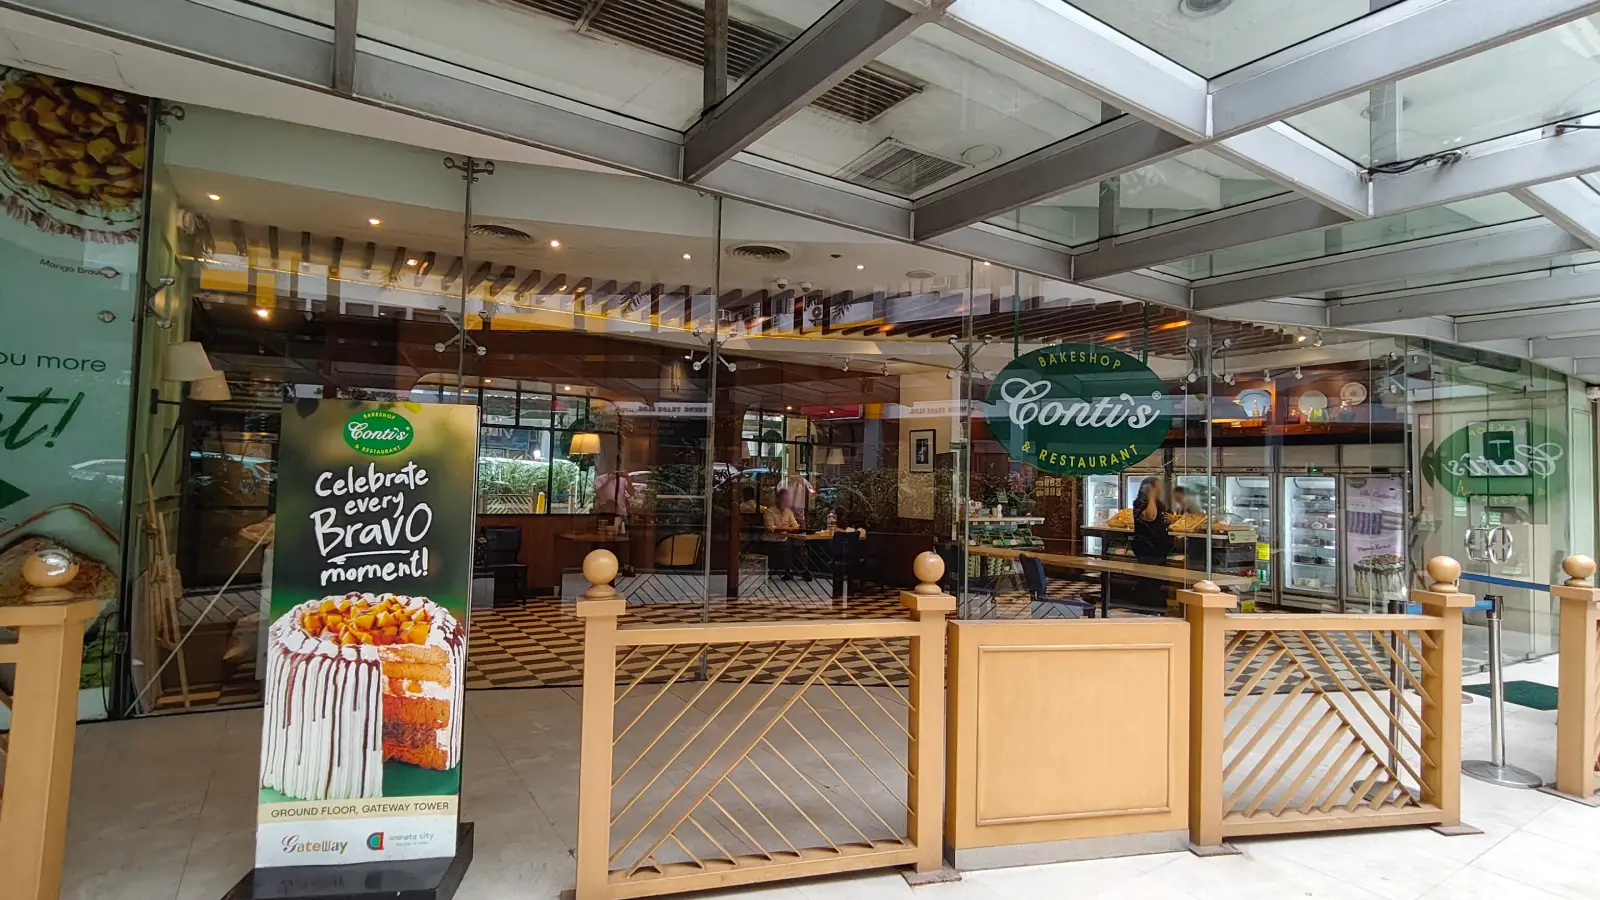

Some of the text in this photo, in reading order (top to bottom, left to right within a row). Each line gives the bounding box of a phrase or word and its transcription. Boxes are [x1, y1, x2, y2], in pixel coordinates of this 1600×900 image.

[40, 259, 75, 273] Mango
[36, 355, 107, 372] more
[1038, 351, 1121, 370] BAKESHOP
[363, 412, 396, 420] BAKESHOP
[348, 421, 409, 441] Conti's
[362, 445, 401, 455] RESTAURANT
[1021, 440, 1139, 469] & RESTAURANT
[314, 461, 429, 497] Celebrate
[344, 491, 404, 519] every
[320, 547, 429, 587] moment!
[271, 801, 449, 818] GROUND FLOOR, GATEWAY TOWER
[419, 831, 434, 841] city
